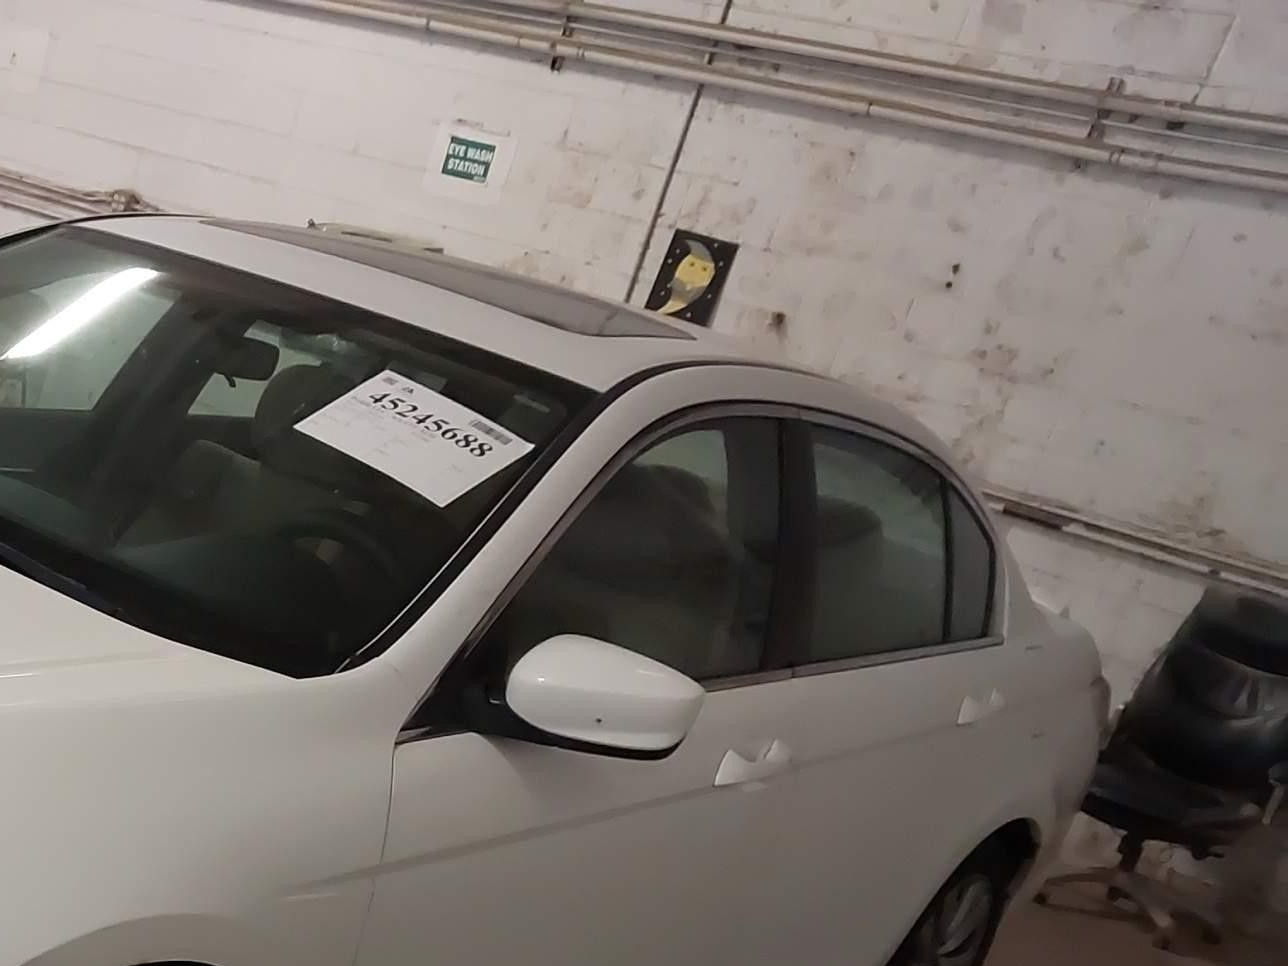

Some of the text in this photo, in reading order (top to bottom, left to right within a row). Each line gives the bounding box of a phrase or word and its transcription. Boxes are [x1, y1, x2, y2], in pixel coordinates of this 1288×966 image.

[448, 143, 493, 163] EYE WASH
[447, 158, 485, 176] STATION
[369, 392, 493, 457] 45245688
